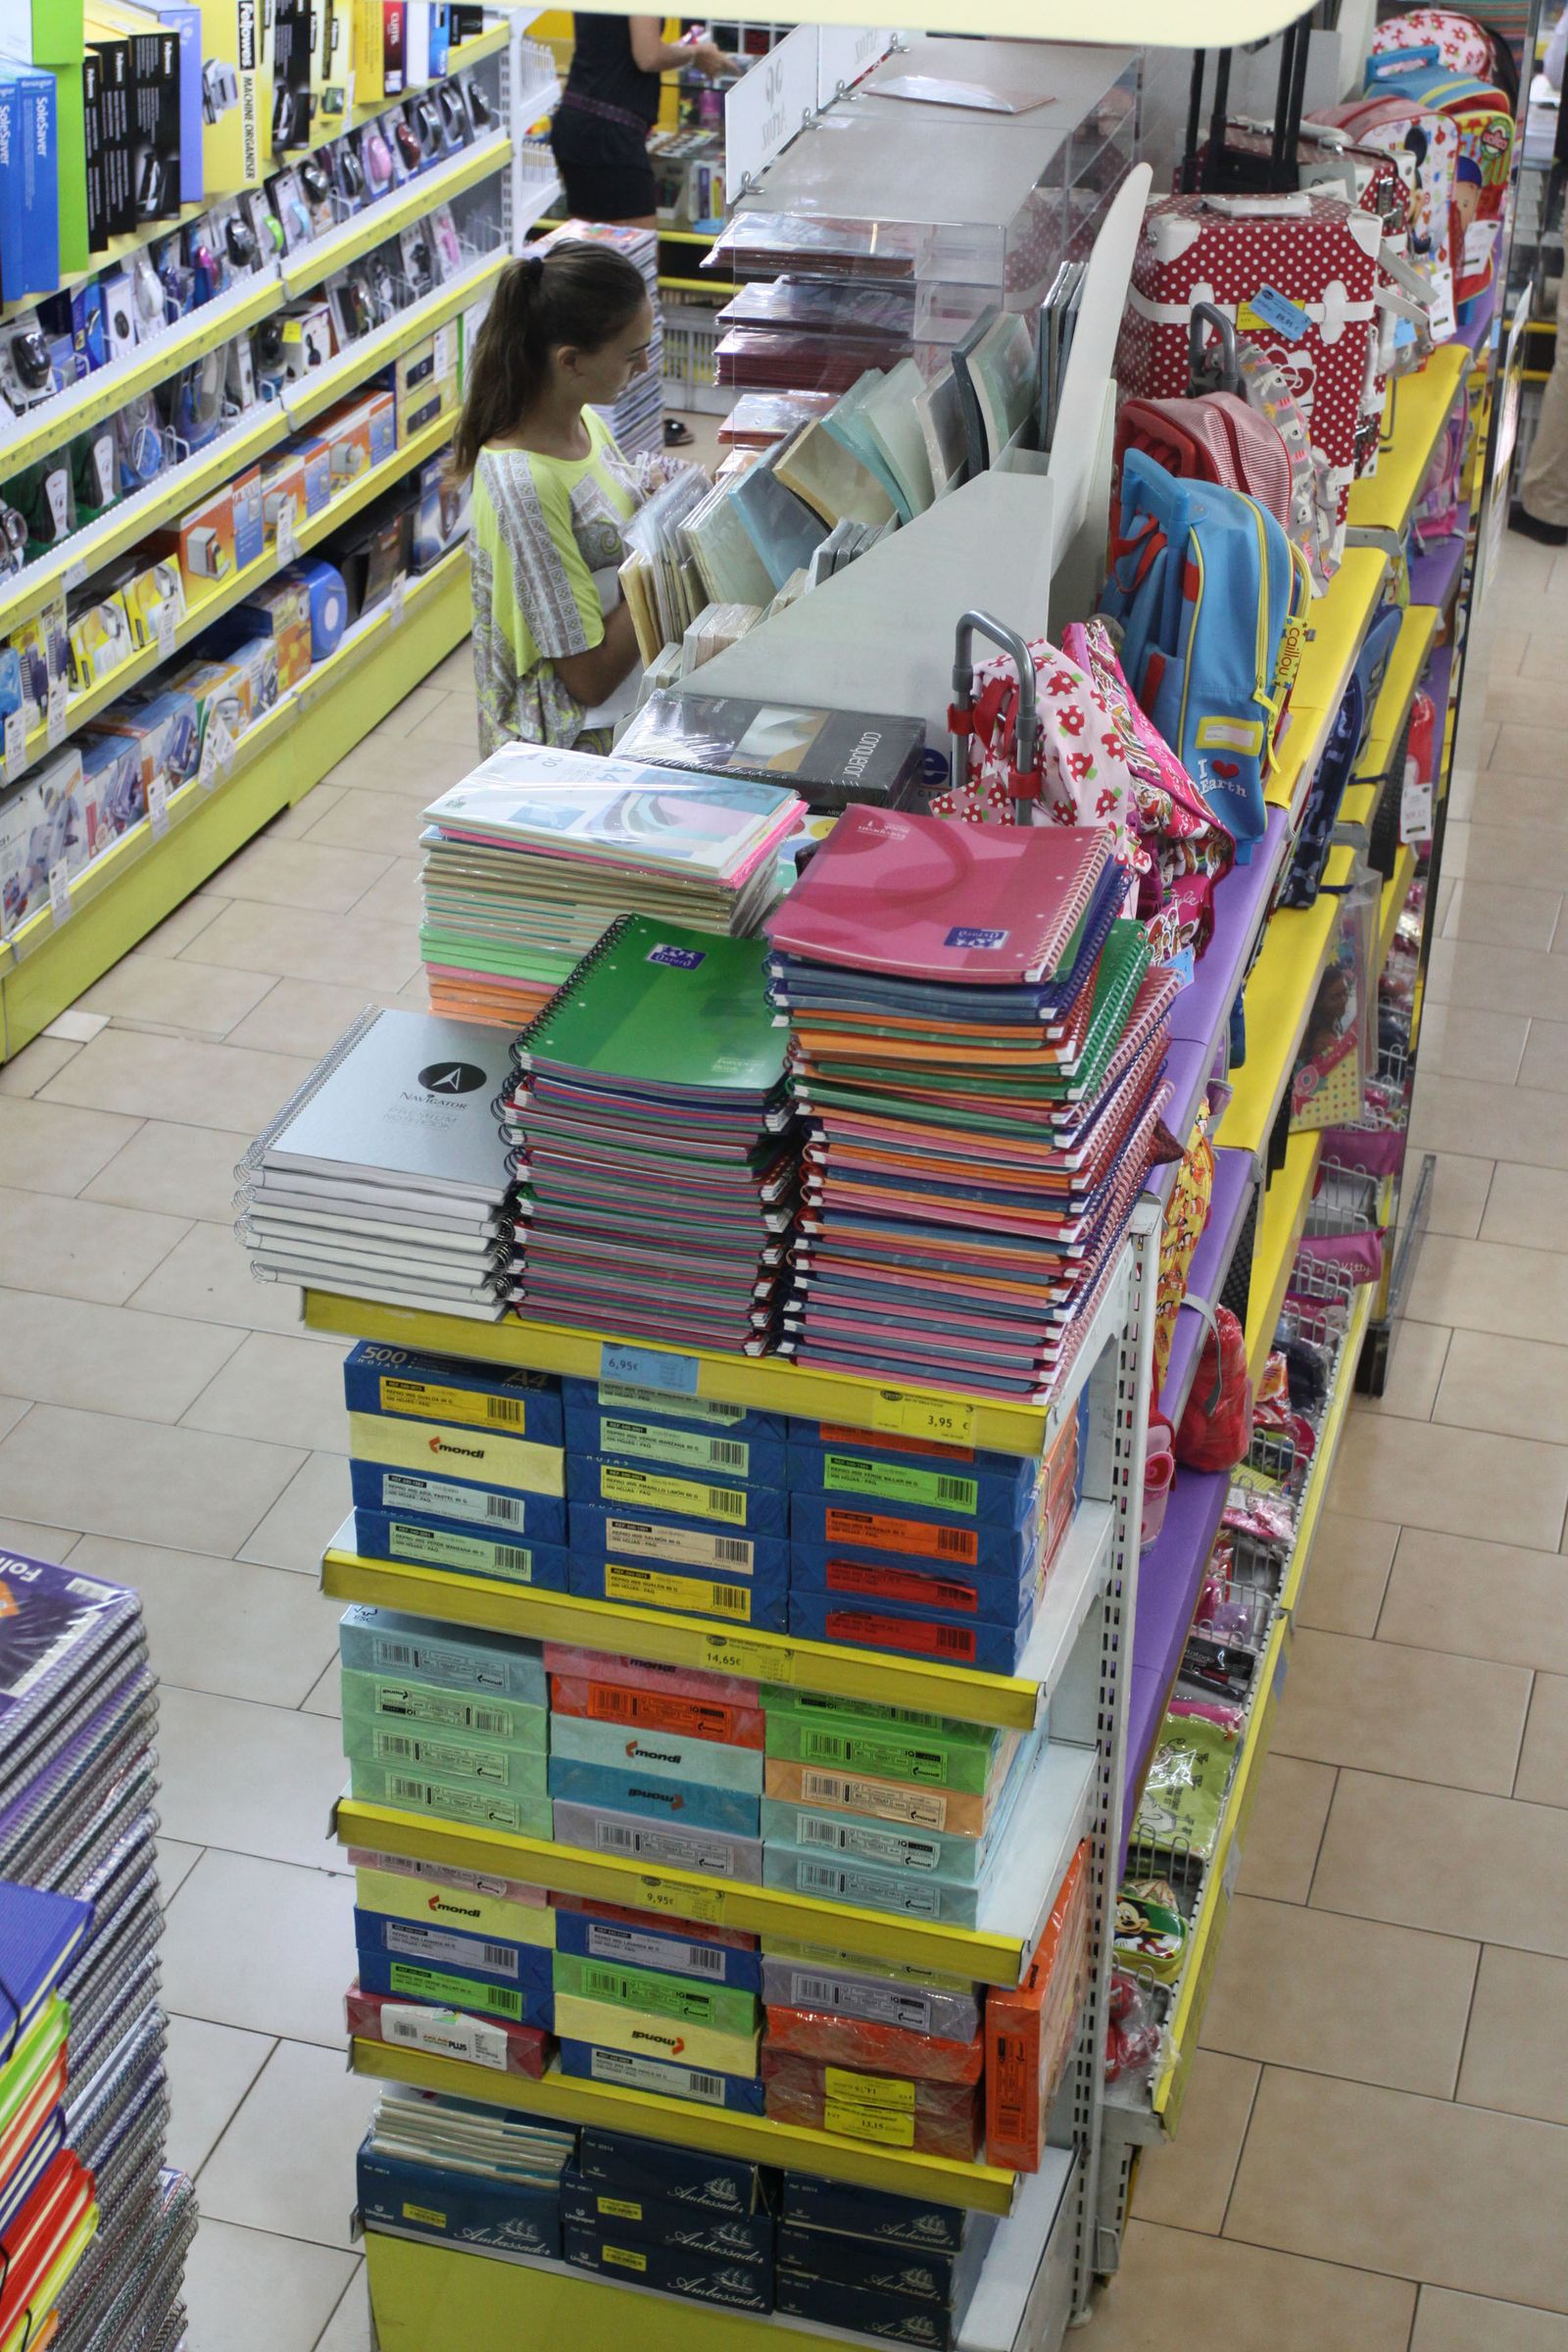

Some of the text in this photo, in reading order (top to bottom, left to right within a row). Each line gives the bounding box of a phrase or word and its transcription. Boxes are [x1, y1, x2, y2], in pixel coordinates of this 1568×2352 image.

[240, 2, 253, 67] Fellowes
[0, 104, 12, 168] SoleSaver
[35, 96, 49, 158] SoleSaver
[243, 76, 256, 179] MACHINE ORGANISER
[1278, 626, 1300, 678] caillou
[1198, 758, 1207, 780] I
[1200, 778, 1248, 798] Earth
[655, 955, 692, 967] Oxford
[357, 1357, 400, 1370] HOJAS
[361, 1346, 408, 1365] 500
[507, 1369, 550, 1388] A4
[927, 1415, 953, 1429] 3,95
[439, 1445, 484, 1459] mondi
[630, 1658, 676, 1673] mondi
[635, 1747, 682, 1764] mondi
[627, 1788, 675, 1803] mondi
[647, 1892, 674, 1905] 9,95€
[437, 1901, 480, 1919] mondi
[448, 2040, 467, 2052] PLUS
[631, 2030, 676, 2046] mondi
[666, 2185, 744, 2214] Ambassador
[453, 2227, 551, 2256] Ambassador
[665, 2230, 764, 2265] Ambassador
[666, 2277, 765, 2309] Ambassador
